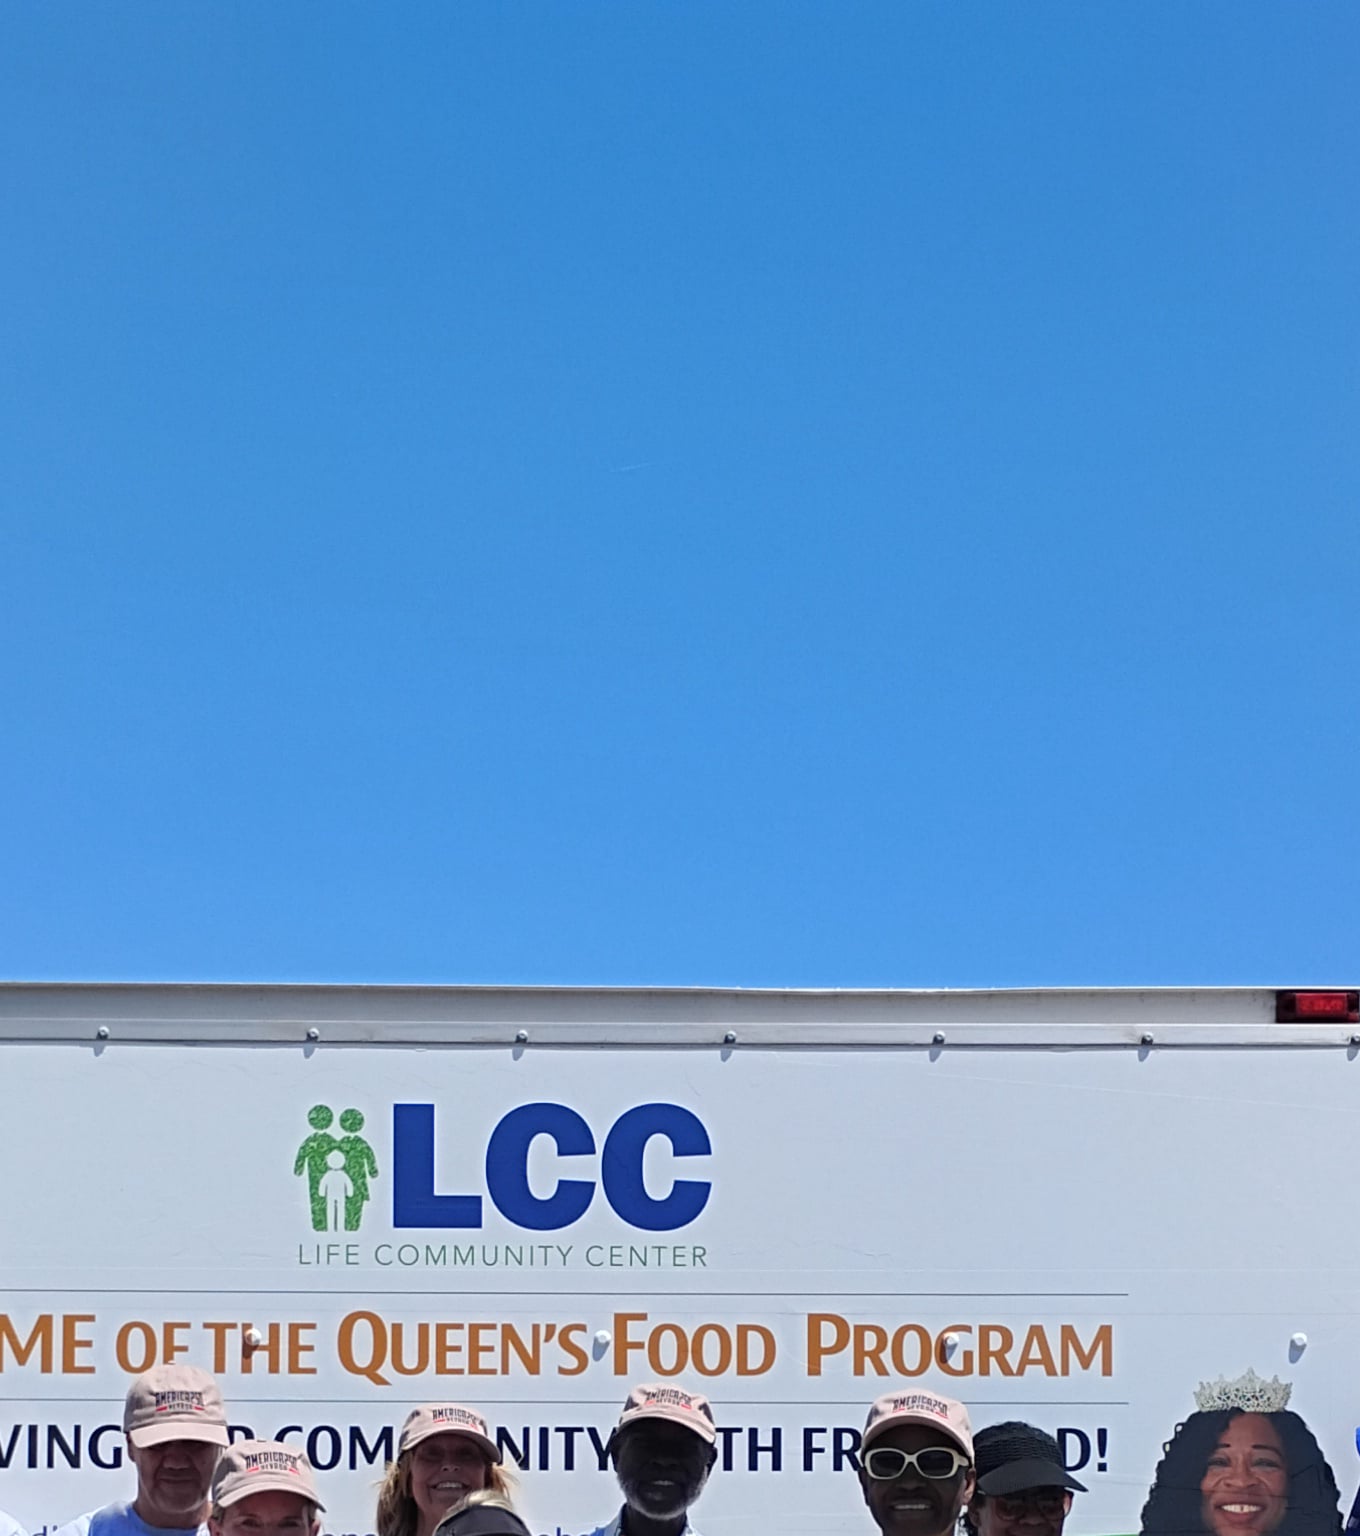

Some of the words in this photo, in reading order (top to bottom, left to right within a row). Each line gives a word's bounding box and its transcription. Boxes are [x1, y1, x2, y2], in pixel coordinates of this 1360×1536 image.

[393, 1102, 712, 1232] LCC
[298, 1243, 360, 1266] LIFE
[374, 1244, 574, 1267] COMMUNITY
[585, 1245, 708, 1268] CENTER
[116, 1321, 191, 1373] OF
[204, 1321, 318, 1375] THE
[337, 1310, 588, 1387] QUEEN'S
[612, 1312, 776, 1377] FOOD
[806, 1313, 1114, 1377] PROGRAM
